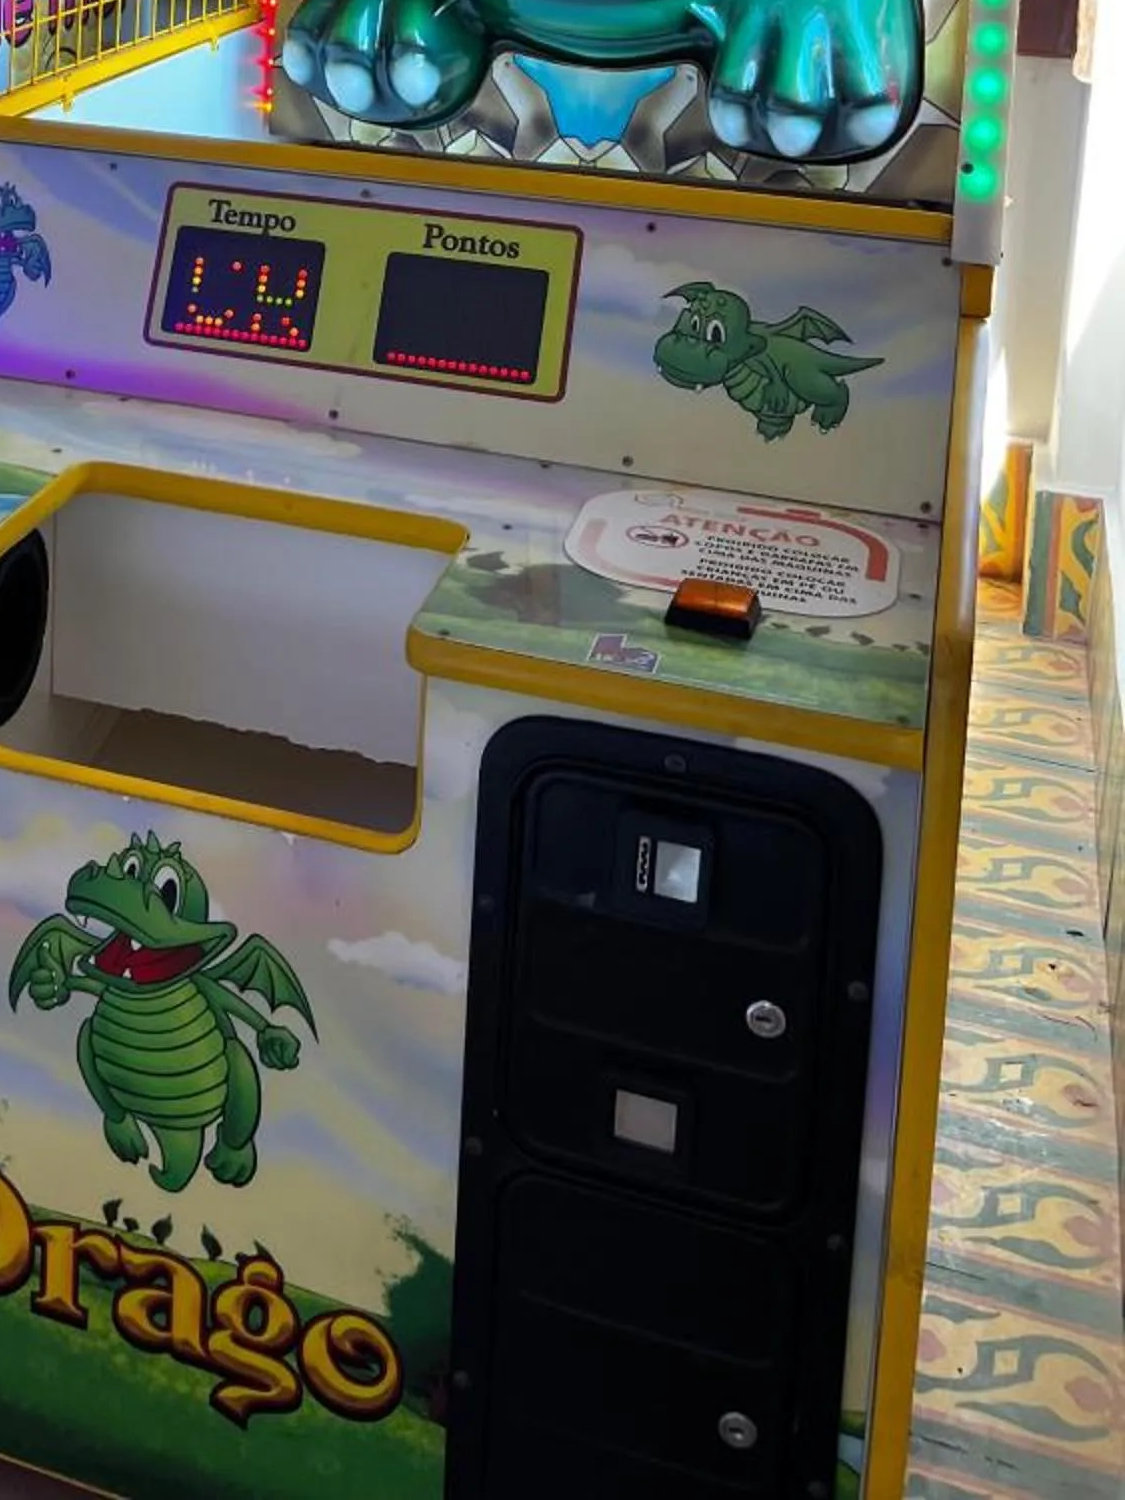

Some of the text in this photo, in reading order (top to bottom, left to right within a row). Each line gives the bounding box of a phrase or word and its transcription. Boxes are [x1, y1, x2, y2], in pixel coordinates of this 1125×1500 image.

[208, 198, 521, 260] Tempo Pontos
[660, 512, 820, 548] ATENÇÃO
